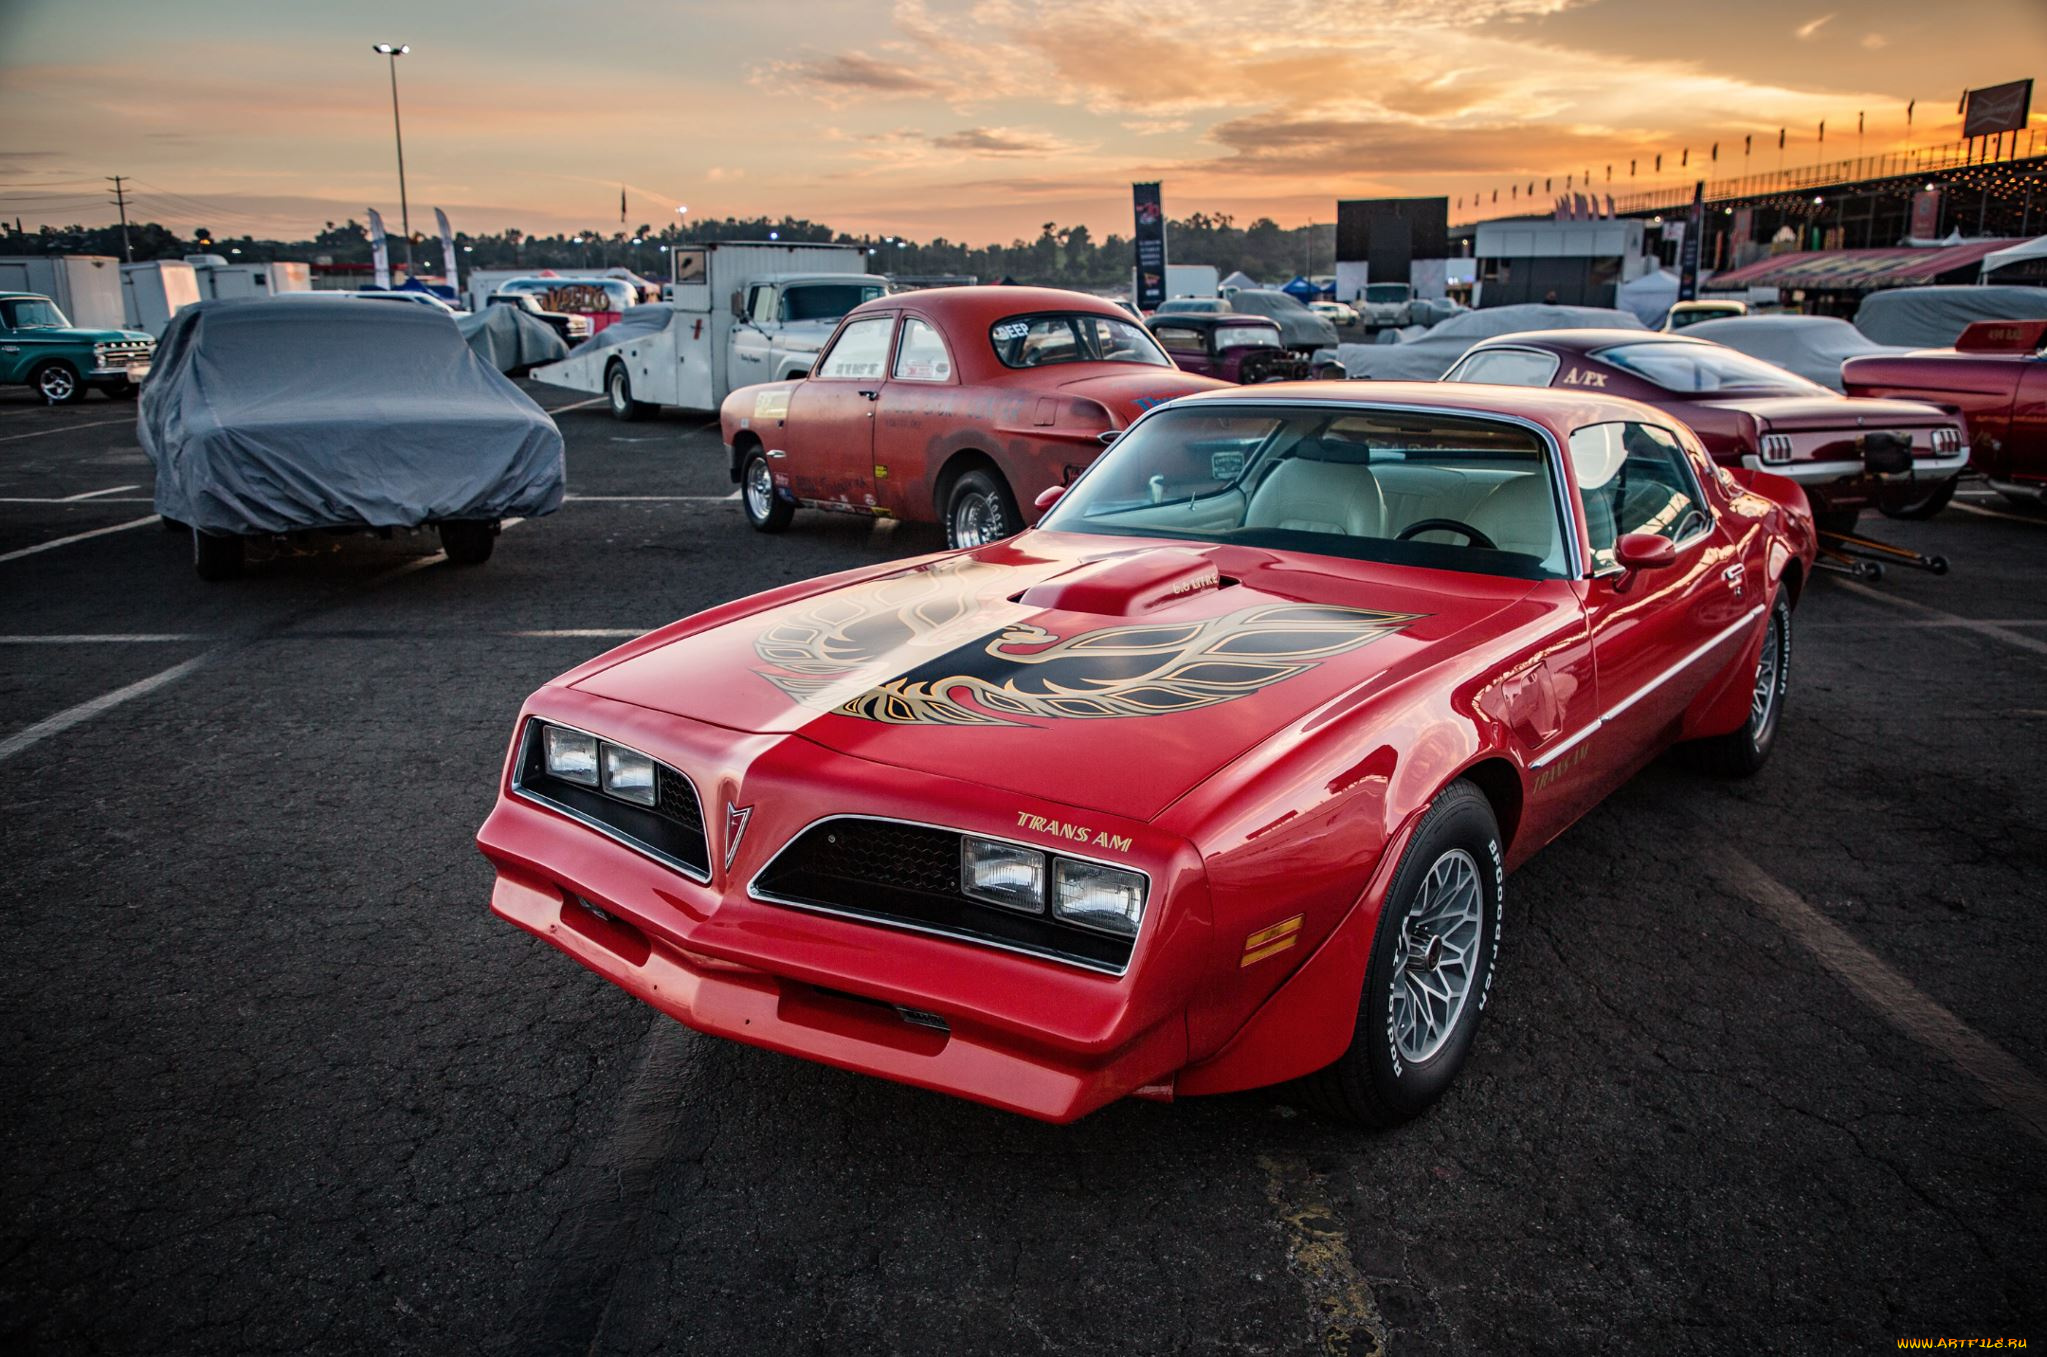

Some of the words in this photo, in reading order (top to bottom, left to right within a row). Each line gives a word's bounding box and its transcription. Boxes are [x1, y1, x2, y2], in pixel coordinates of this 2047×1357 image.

[1172, 582, 1190, 594] 6.6
[1191, 573, 1218, 590] LITRE
[1018, 811, 1091, 842] TRANS
[1092, 832, 1133, 852] AM
[1479, 840, 1503, 1011] BFGoodrich
[1387, 982, 1402, 1078] Radial
